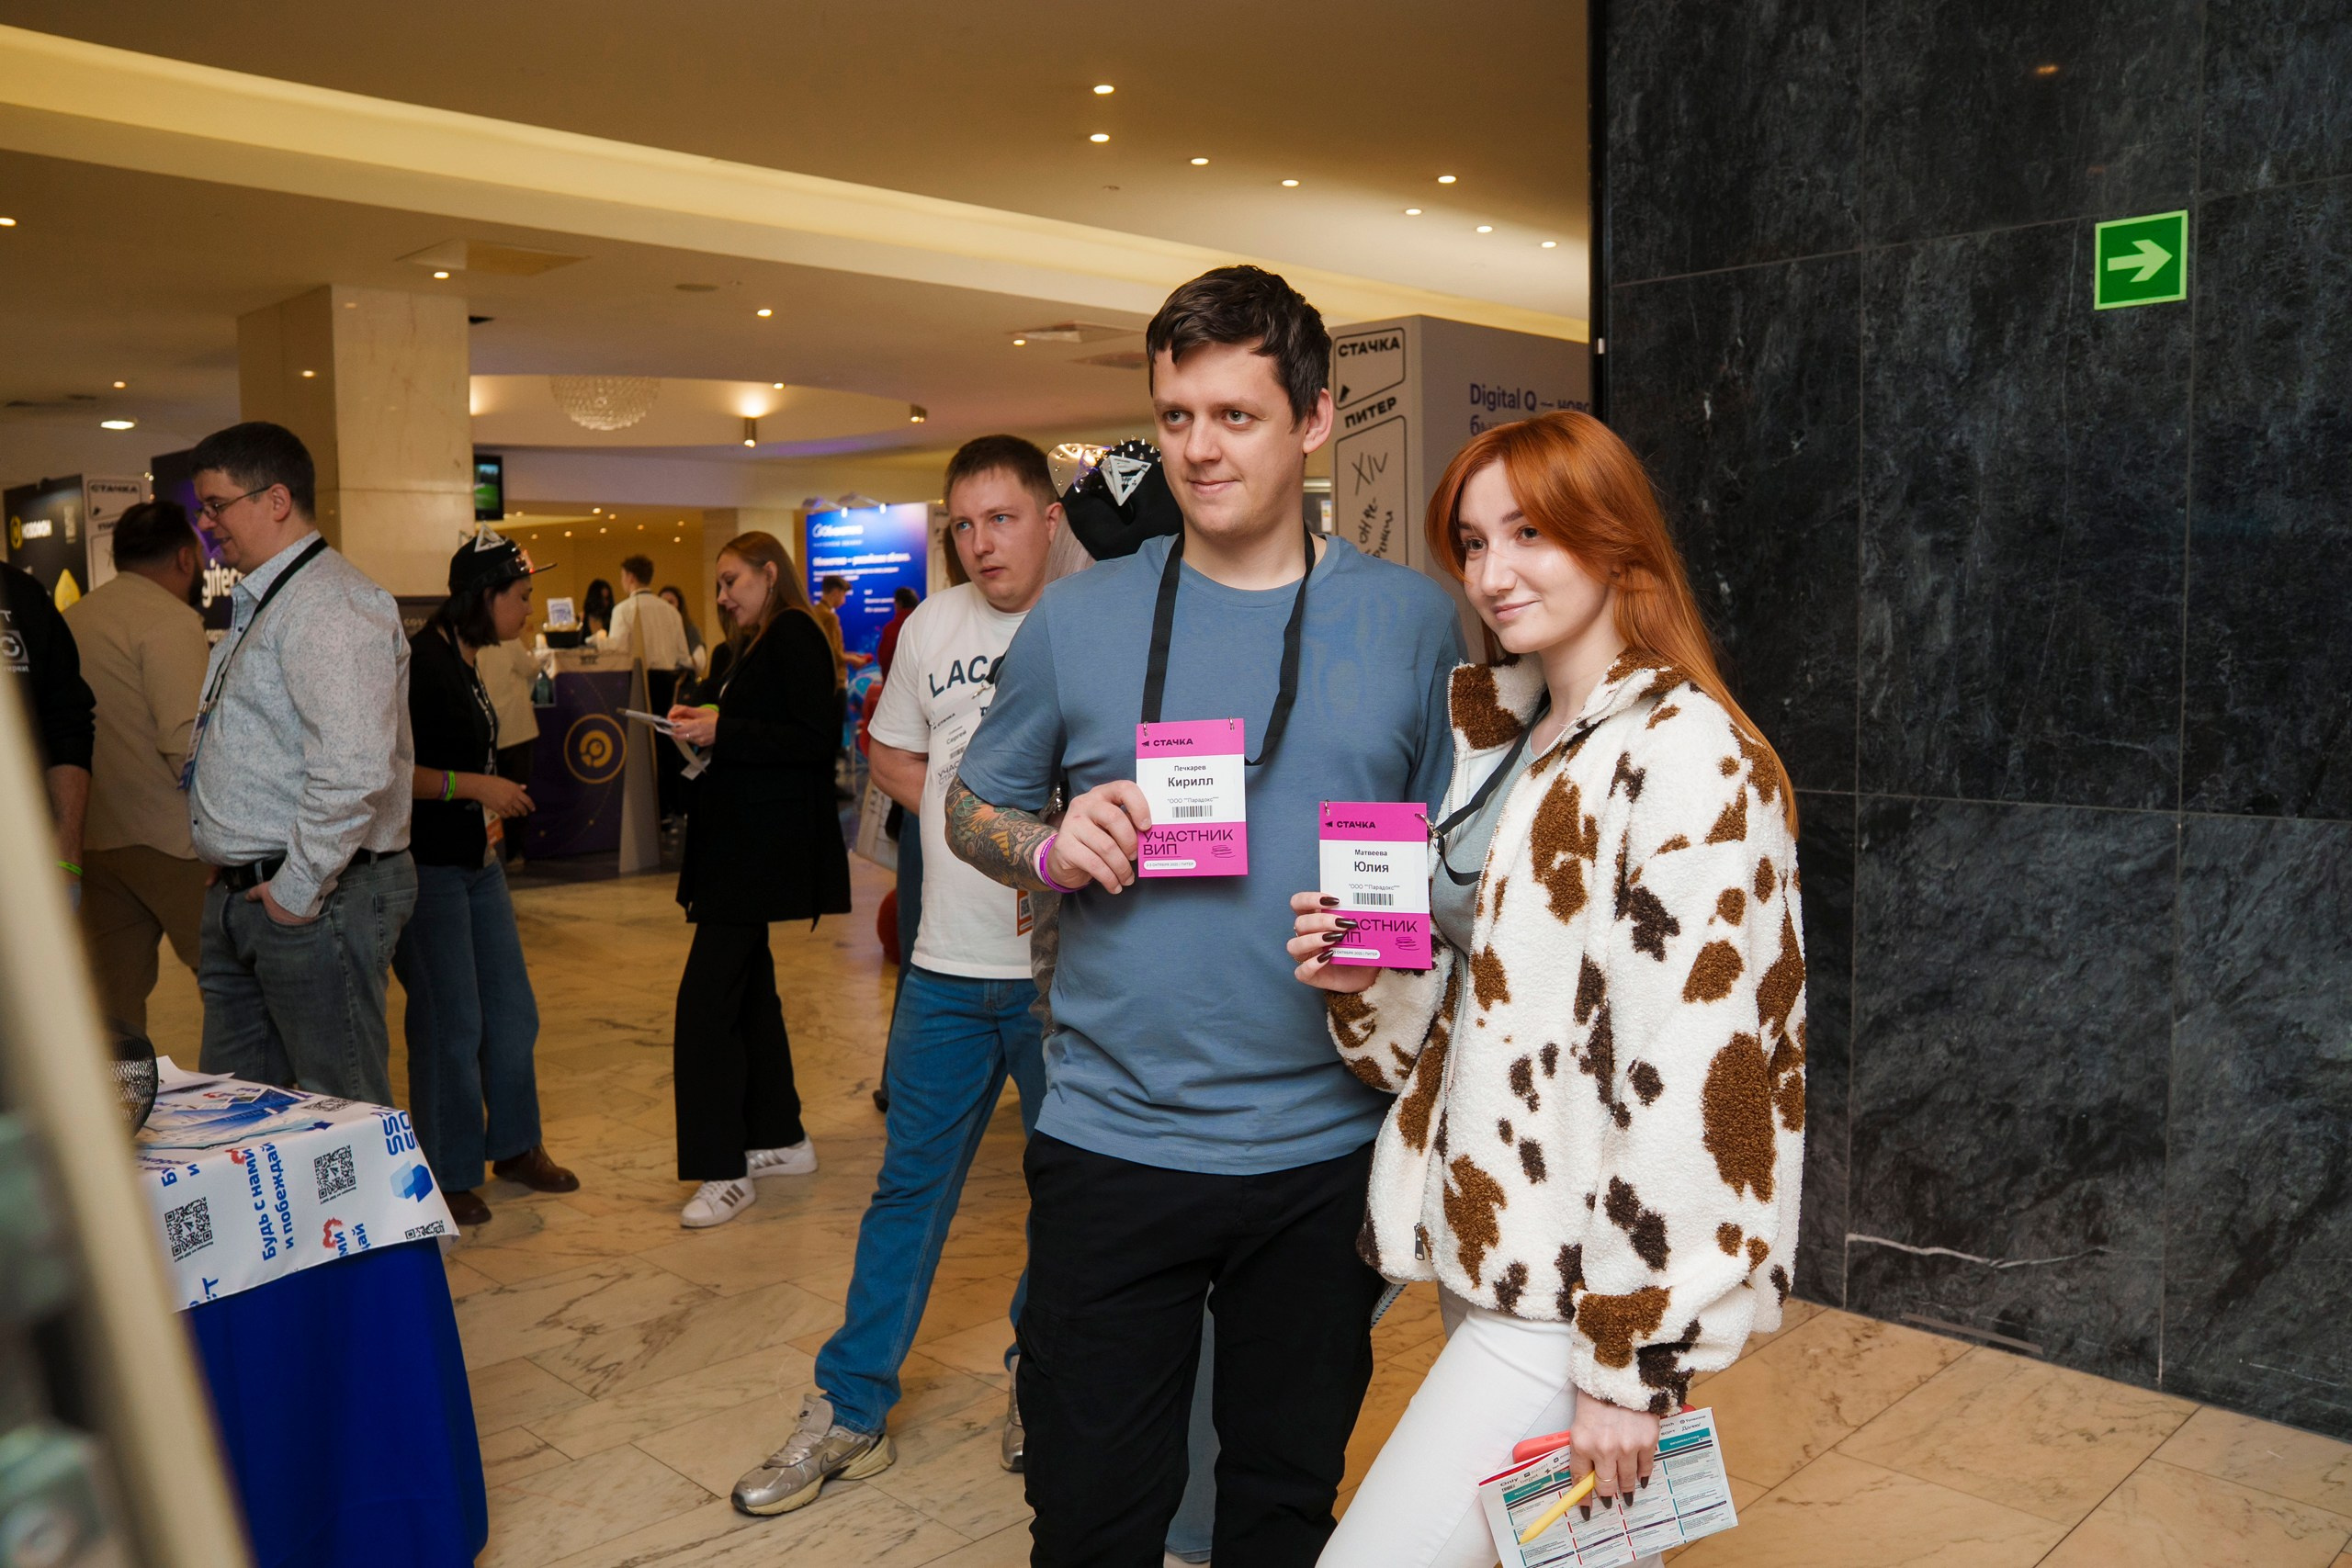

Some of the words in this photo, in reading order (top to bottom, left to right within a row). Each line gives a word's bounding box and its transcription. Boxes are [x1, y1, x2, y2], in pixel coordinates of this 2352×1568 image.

[1338, 336, 1401, 357] СТАЧКА
[1470, 383, 1521, 412] Digital
[1524, 389, 1537, 412] Q
[1344, 396, 1396, 428] ПИТЕР
[1153, 738, 1193, 747] СТАЧКА
[937, 761, 960, 778] УЧАС
[1168, 777, 1214, 789] Кирилл
[1336, 820, 1376, 829] СТАЧКА
[1144, 829, 1234, 843] УЧАСТНИК
[1143, 843, 1178, 856] ВИП
[1354, 849, 1388, 857] Матвеева
[1353, 861, 1389, 873] Юлия
[1350, 918, 1418, 933] АСТНИК
[1341, 931, 1362, 943] ИП
[243, 1148, 263, 1198] нами
[260, 1142, 293, 1235] побеждай
[254, 1199, 266, 1212] с
[258, 1213, 277, 1261] Будь
[285, 1235, 294, 1250] и
[1499, 1477, 1519, 1487] Only
